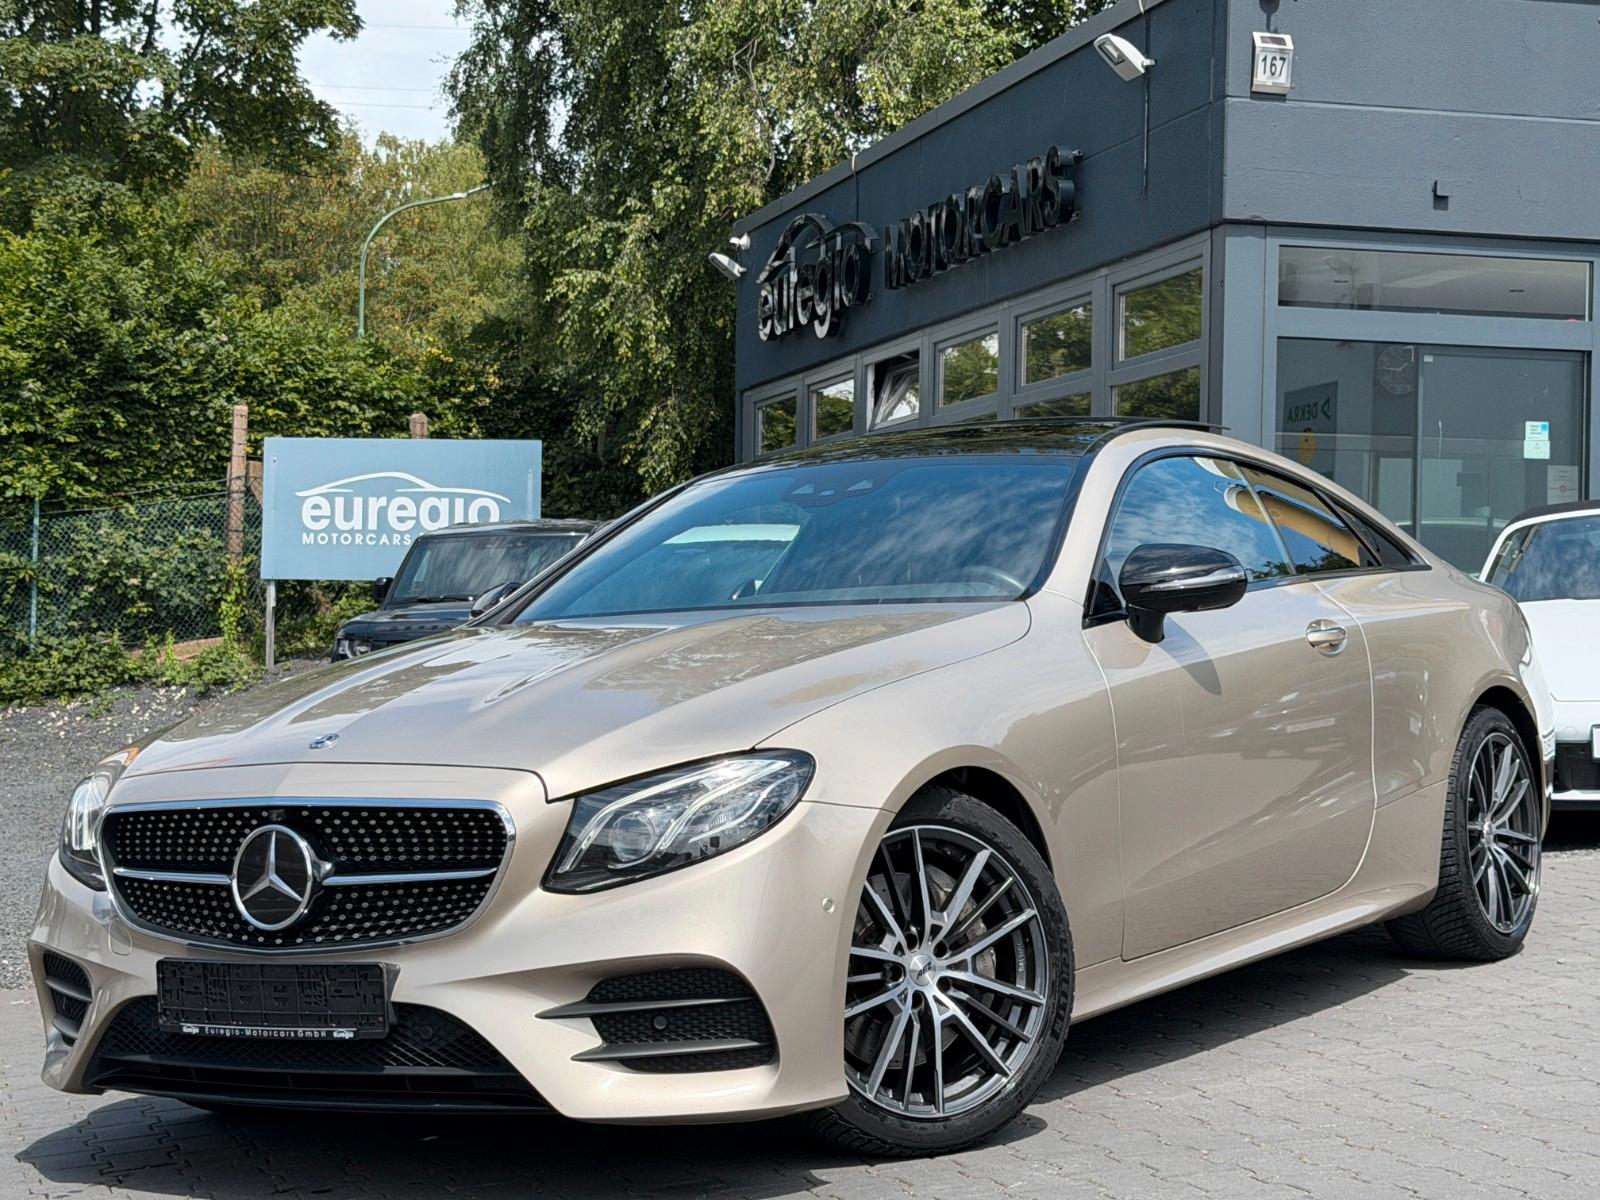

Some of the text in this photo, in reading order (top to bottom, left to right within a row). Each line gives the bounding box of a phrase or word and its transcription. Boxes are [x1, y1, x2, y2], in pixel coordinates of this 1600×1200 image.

[1261, 55, 1287, 77] 167
[885, 146, 1076, 290] MOTORCARS
[302, 533, 411, 545] MOTORCARS
